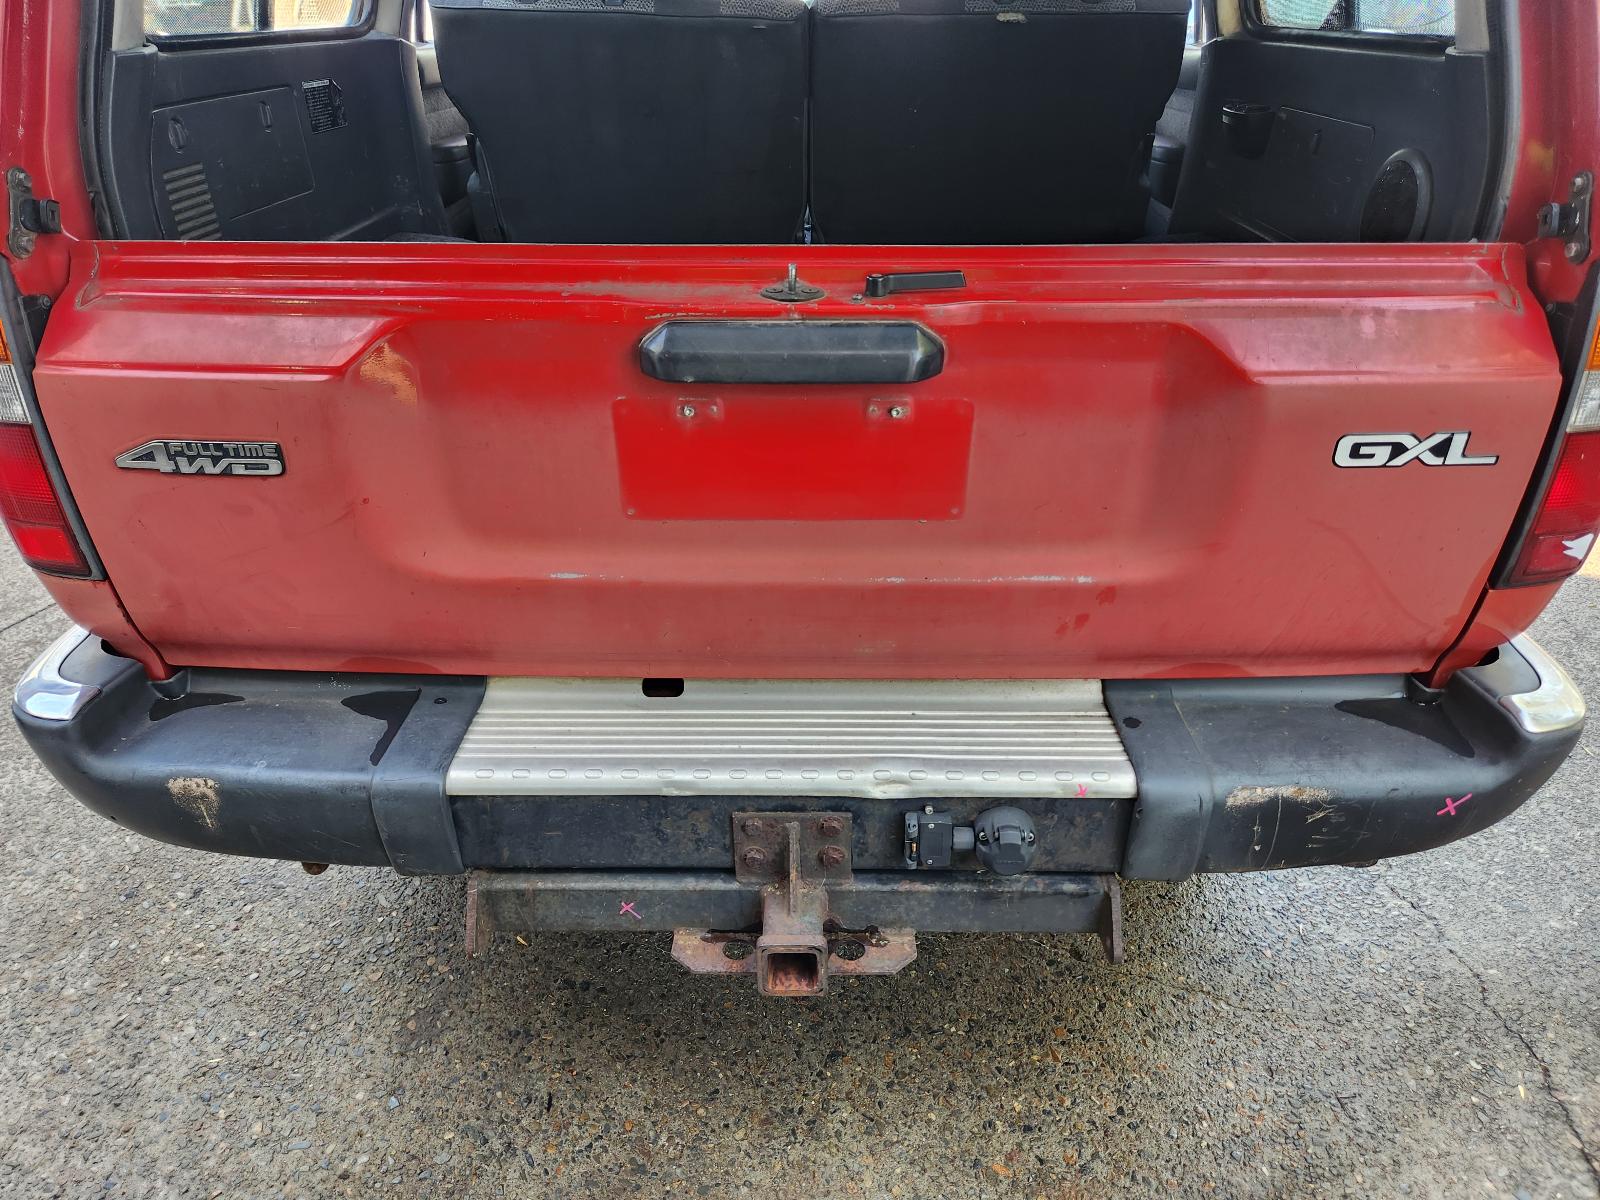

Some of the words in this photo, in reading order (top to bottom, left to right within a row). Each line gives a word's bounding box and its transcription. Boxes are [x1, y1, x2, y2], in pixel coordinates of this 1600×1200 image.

[115, 441, 283, 475] 4WD
[168, 442, 223, 456] FULL
[223, 443, 278, 457] TIME
[1332, 431, 1499, 468] GXL
